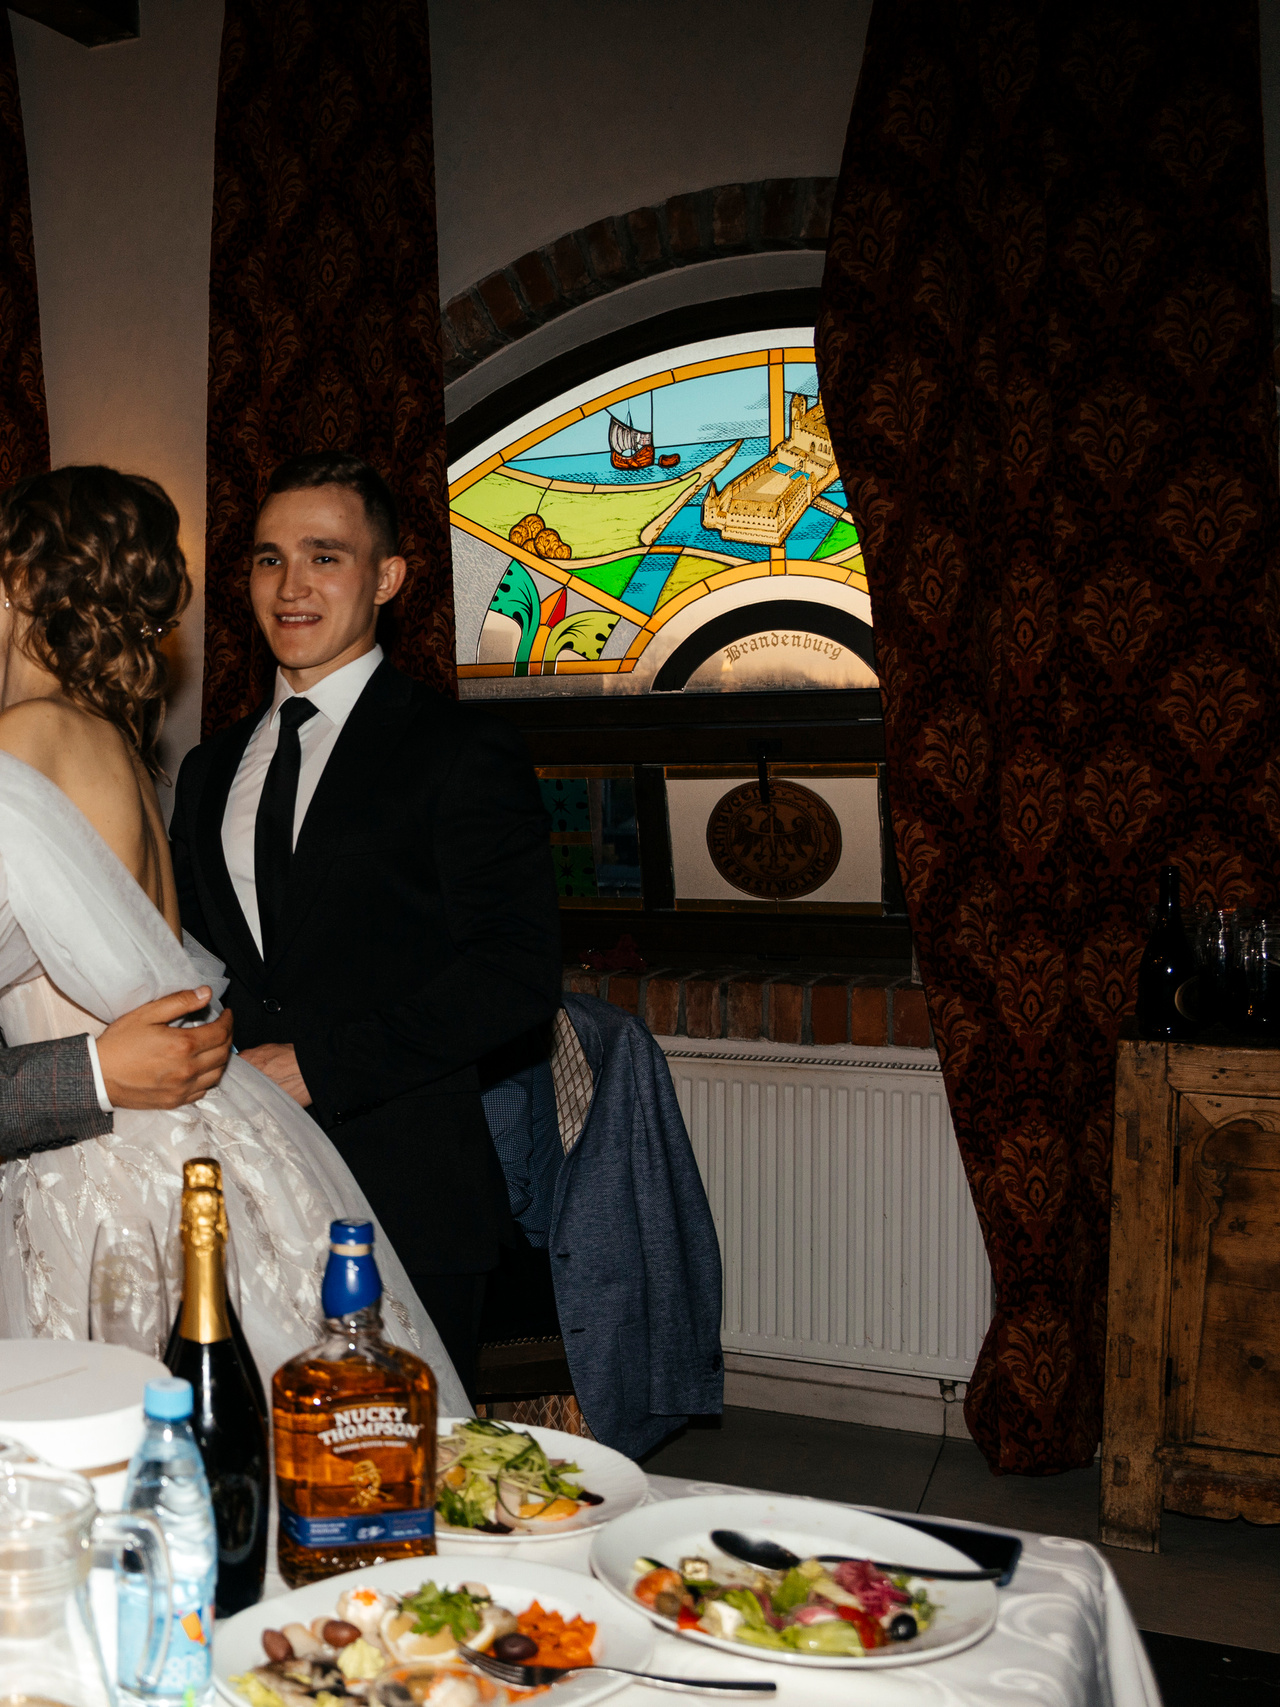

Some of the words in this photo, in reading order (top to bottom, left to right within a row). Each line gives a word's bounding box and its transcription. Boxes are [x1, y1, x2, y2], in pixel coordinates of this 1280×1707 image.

[723, 632, 844, 664] Brandenburg
[332, 1406, 408, 1428] NUCKY
[317, 1421, 420, 1446] THOMPSON
